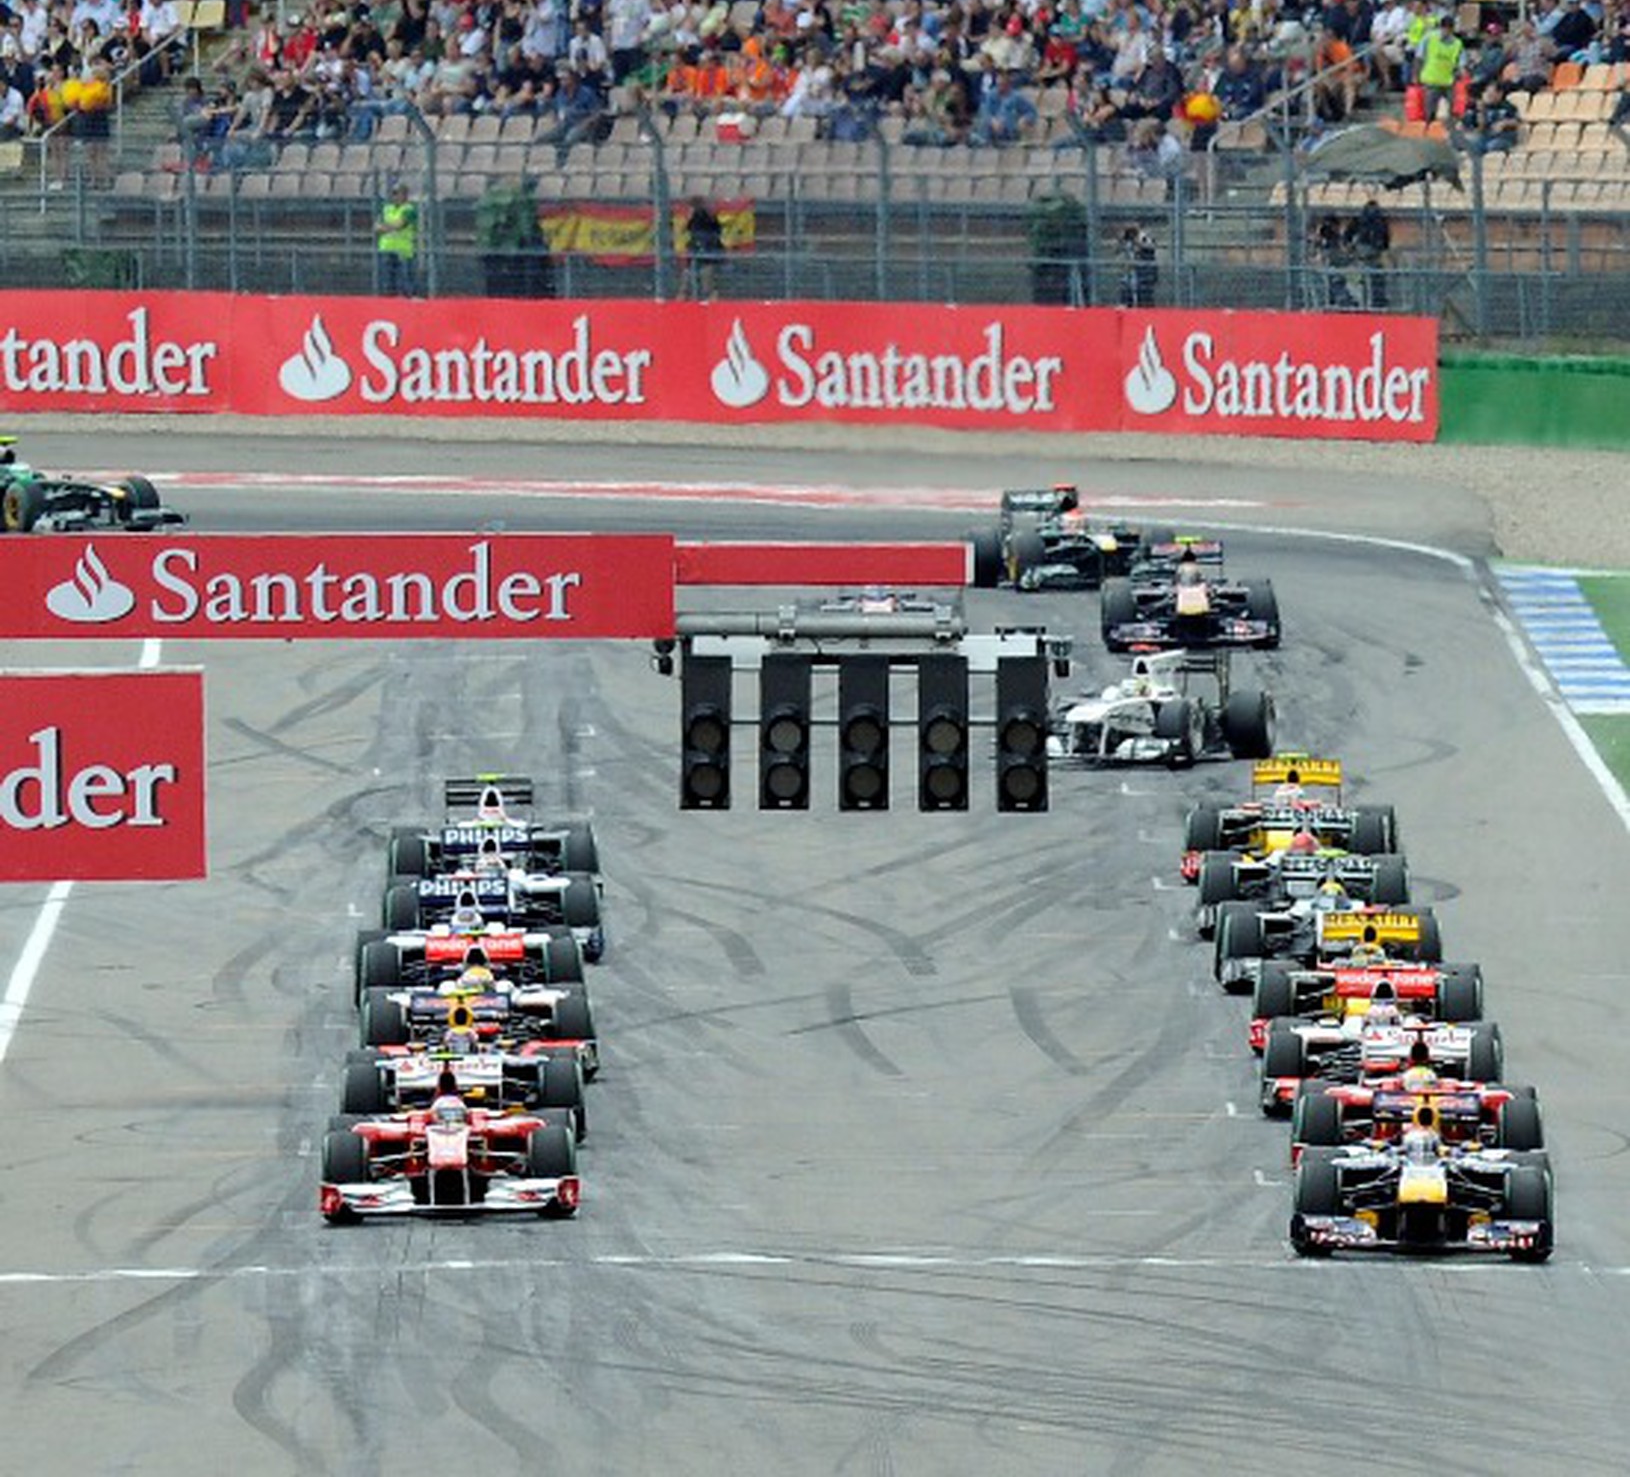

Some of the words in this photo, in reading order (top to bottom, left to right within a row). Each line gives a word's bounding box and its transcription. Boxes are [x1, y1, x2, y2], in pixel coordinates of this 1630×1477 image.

[360, 316, 651, 404] Santander
[774, 322, 1062, 414] Santander
[1182, 332, 1430, 422] Santander
[151, 542, 581, 623] Santander
